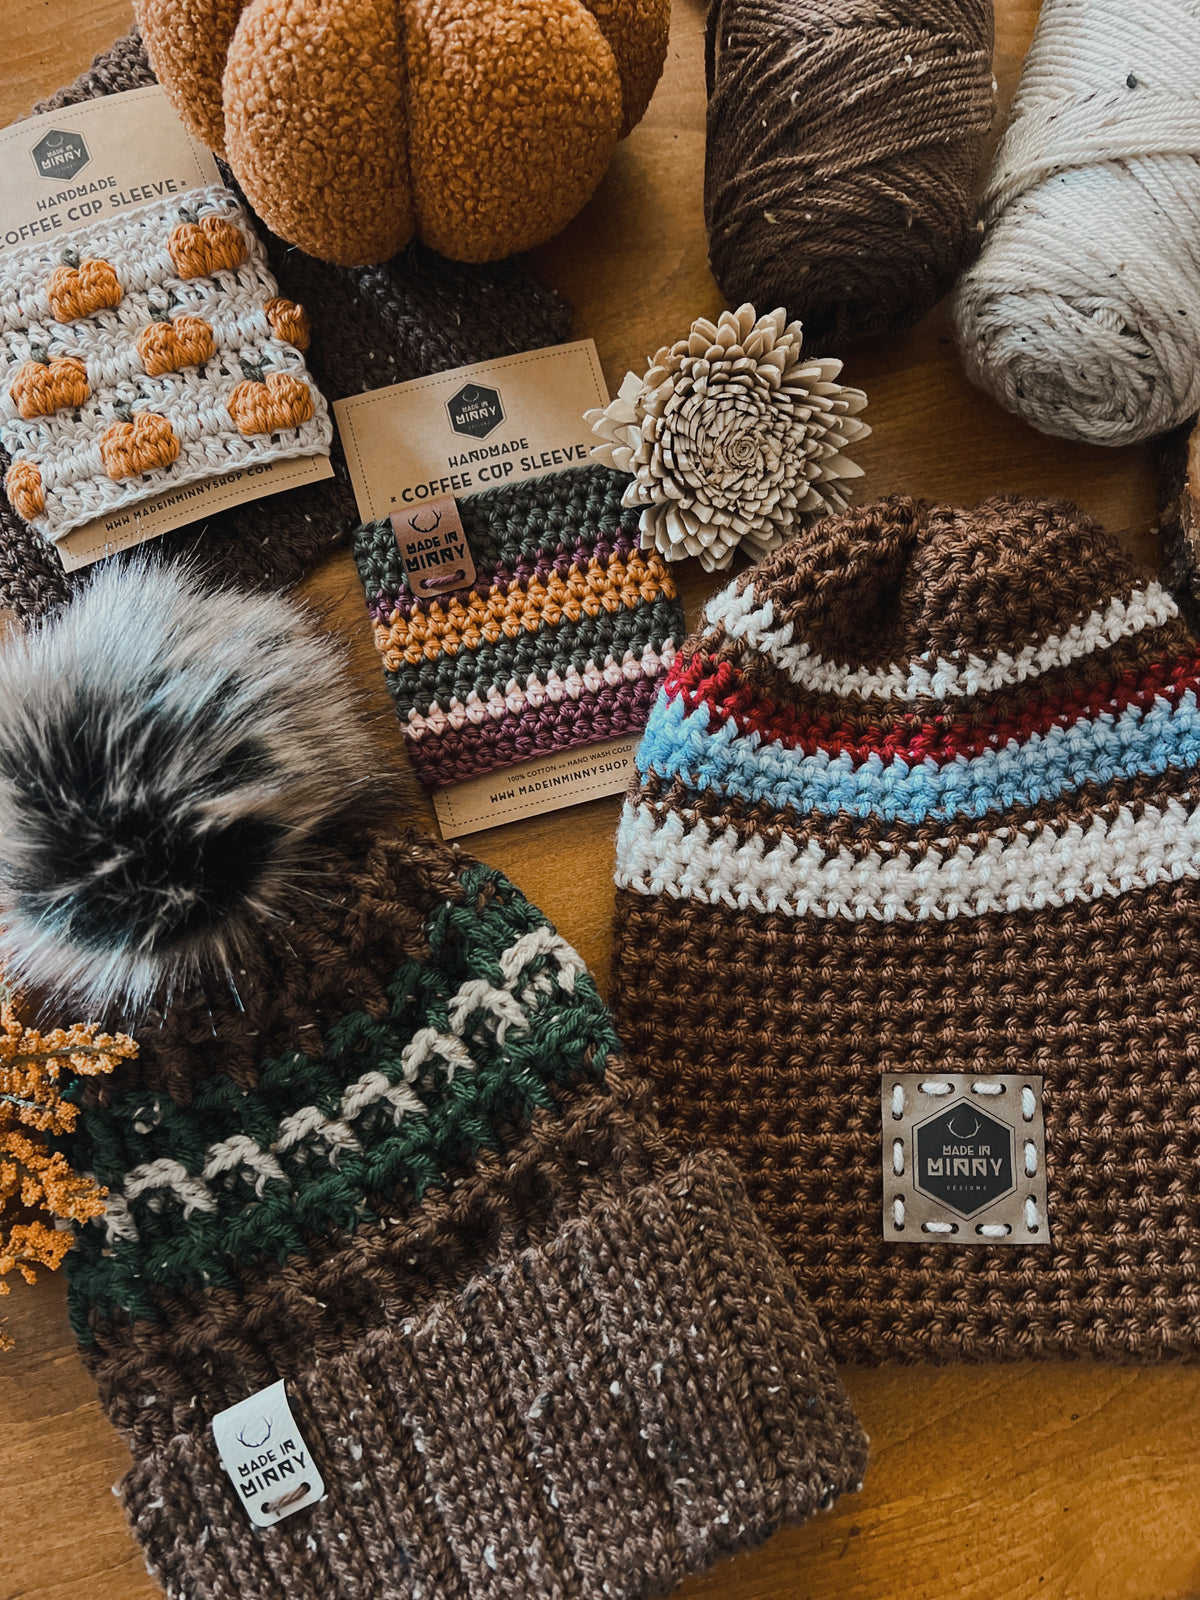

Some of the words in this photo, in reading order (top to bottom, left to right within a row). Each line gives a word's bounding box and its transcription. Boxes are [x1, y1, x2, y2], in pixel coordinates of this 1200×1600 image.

[41, 148, 81, 170] MINNY
[36, 175, 117, 212] HANDMADE
[67, 200, 103, 222] CUP
[109, 179, 178, 208] SLEEVE
[455, 405, 496, 425] MINNY
[448, 437, 529, 468] HANDMADE
[401, 472, 473, 502] COFFEE
[477, 461, 514, 482] CUP
[520, 444, 587, 472] SLEEVE
[405, 543, 465, 573] MINNY
[406, 536, 441, 555] MADE
[444, 531, 458, 545] IN
[507, 774, 526, 783] 100%
[526, 765, 557, 778] COTTON
[567, 756, 588, 767] HAND
[589, 750, 611, 761] WASH
[612, 744, 632, 755] COLD
[942, 1145, 975, 1156] MADE
[978, 1145, 991, 1156] IN
[927, 1158, 1003, 1177] MINNY
[237, 1449, 277, 1477] MADE
[279, 1438, 296, 1456] IN
[239, 1451, 306, 1499] MINNY
